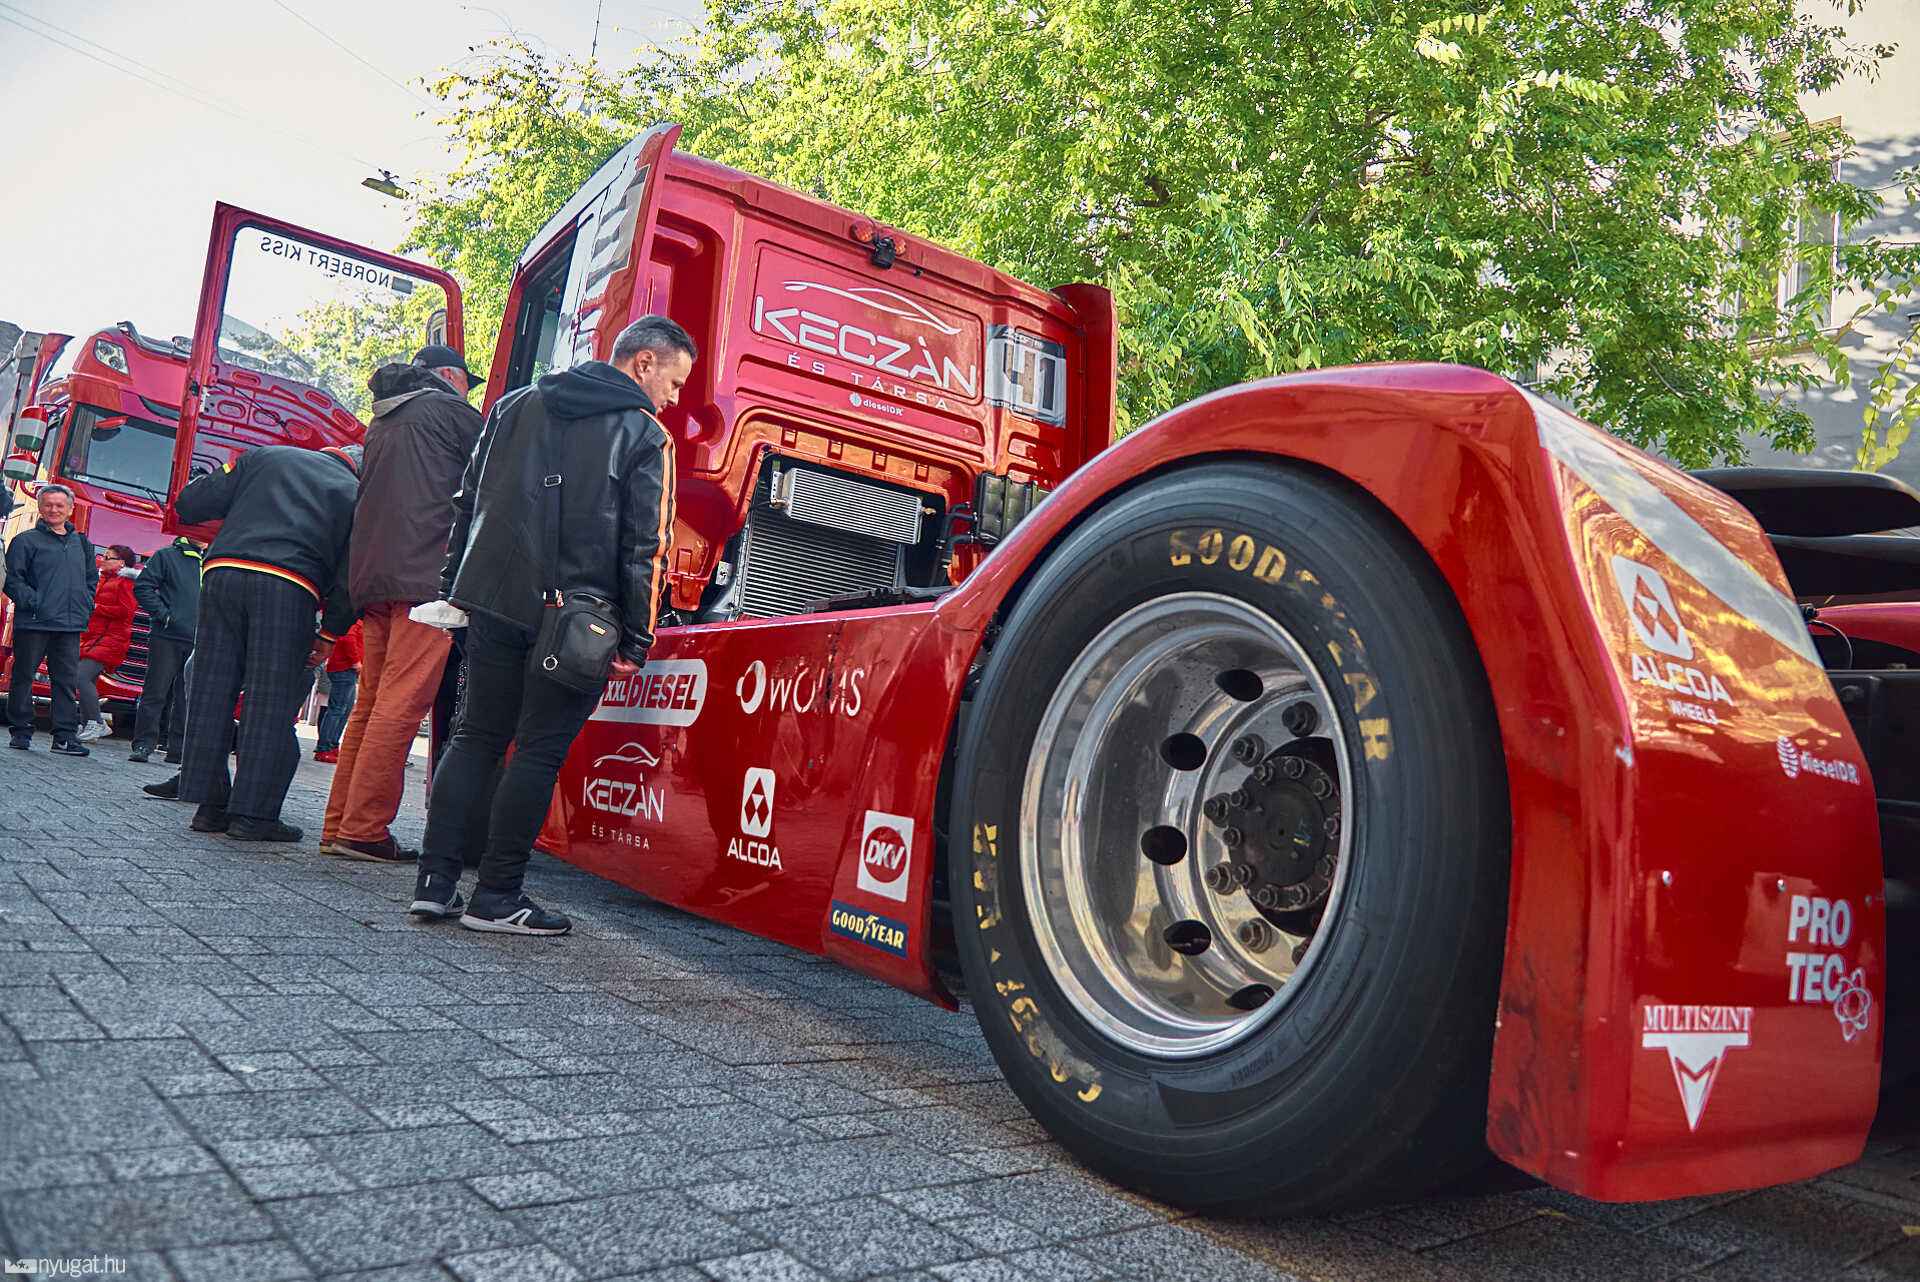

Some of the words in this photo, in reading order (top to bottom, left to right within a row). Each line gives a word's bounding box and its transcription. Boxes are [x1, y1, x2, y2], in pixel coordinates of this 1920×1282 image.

[787, 352, 825, 376] ÉS
[851, 371, 949, 411] TÁRSA
[603, 680, 627, 702] XXL
[627, 673, 699, 710] DIESEL
[1631, 653, 1734, 706] ALCOA
[1667, 699, 1721, 725] WHEELS
[1799, 752, 1860, 784] dieselDR
[591, 821, 604, 838] ÉS
[611, 828, 650, 850] TÁRSA
[726, 837, 783, 870] ALCOA
[865, 839, 905, 871] DKV
[1787, 895, 1851, 947] PRO
[1785, 952, 1845, 1003] TEC
[1642, 1004, 1753, 1032] MULTISZINT
